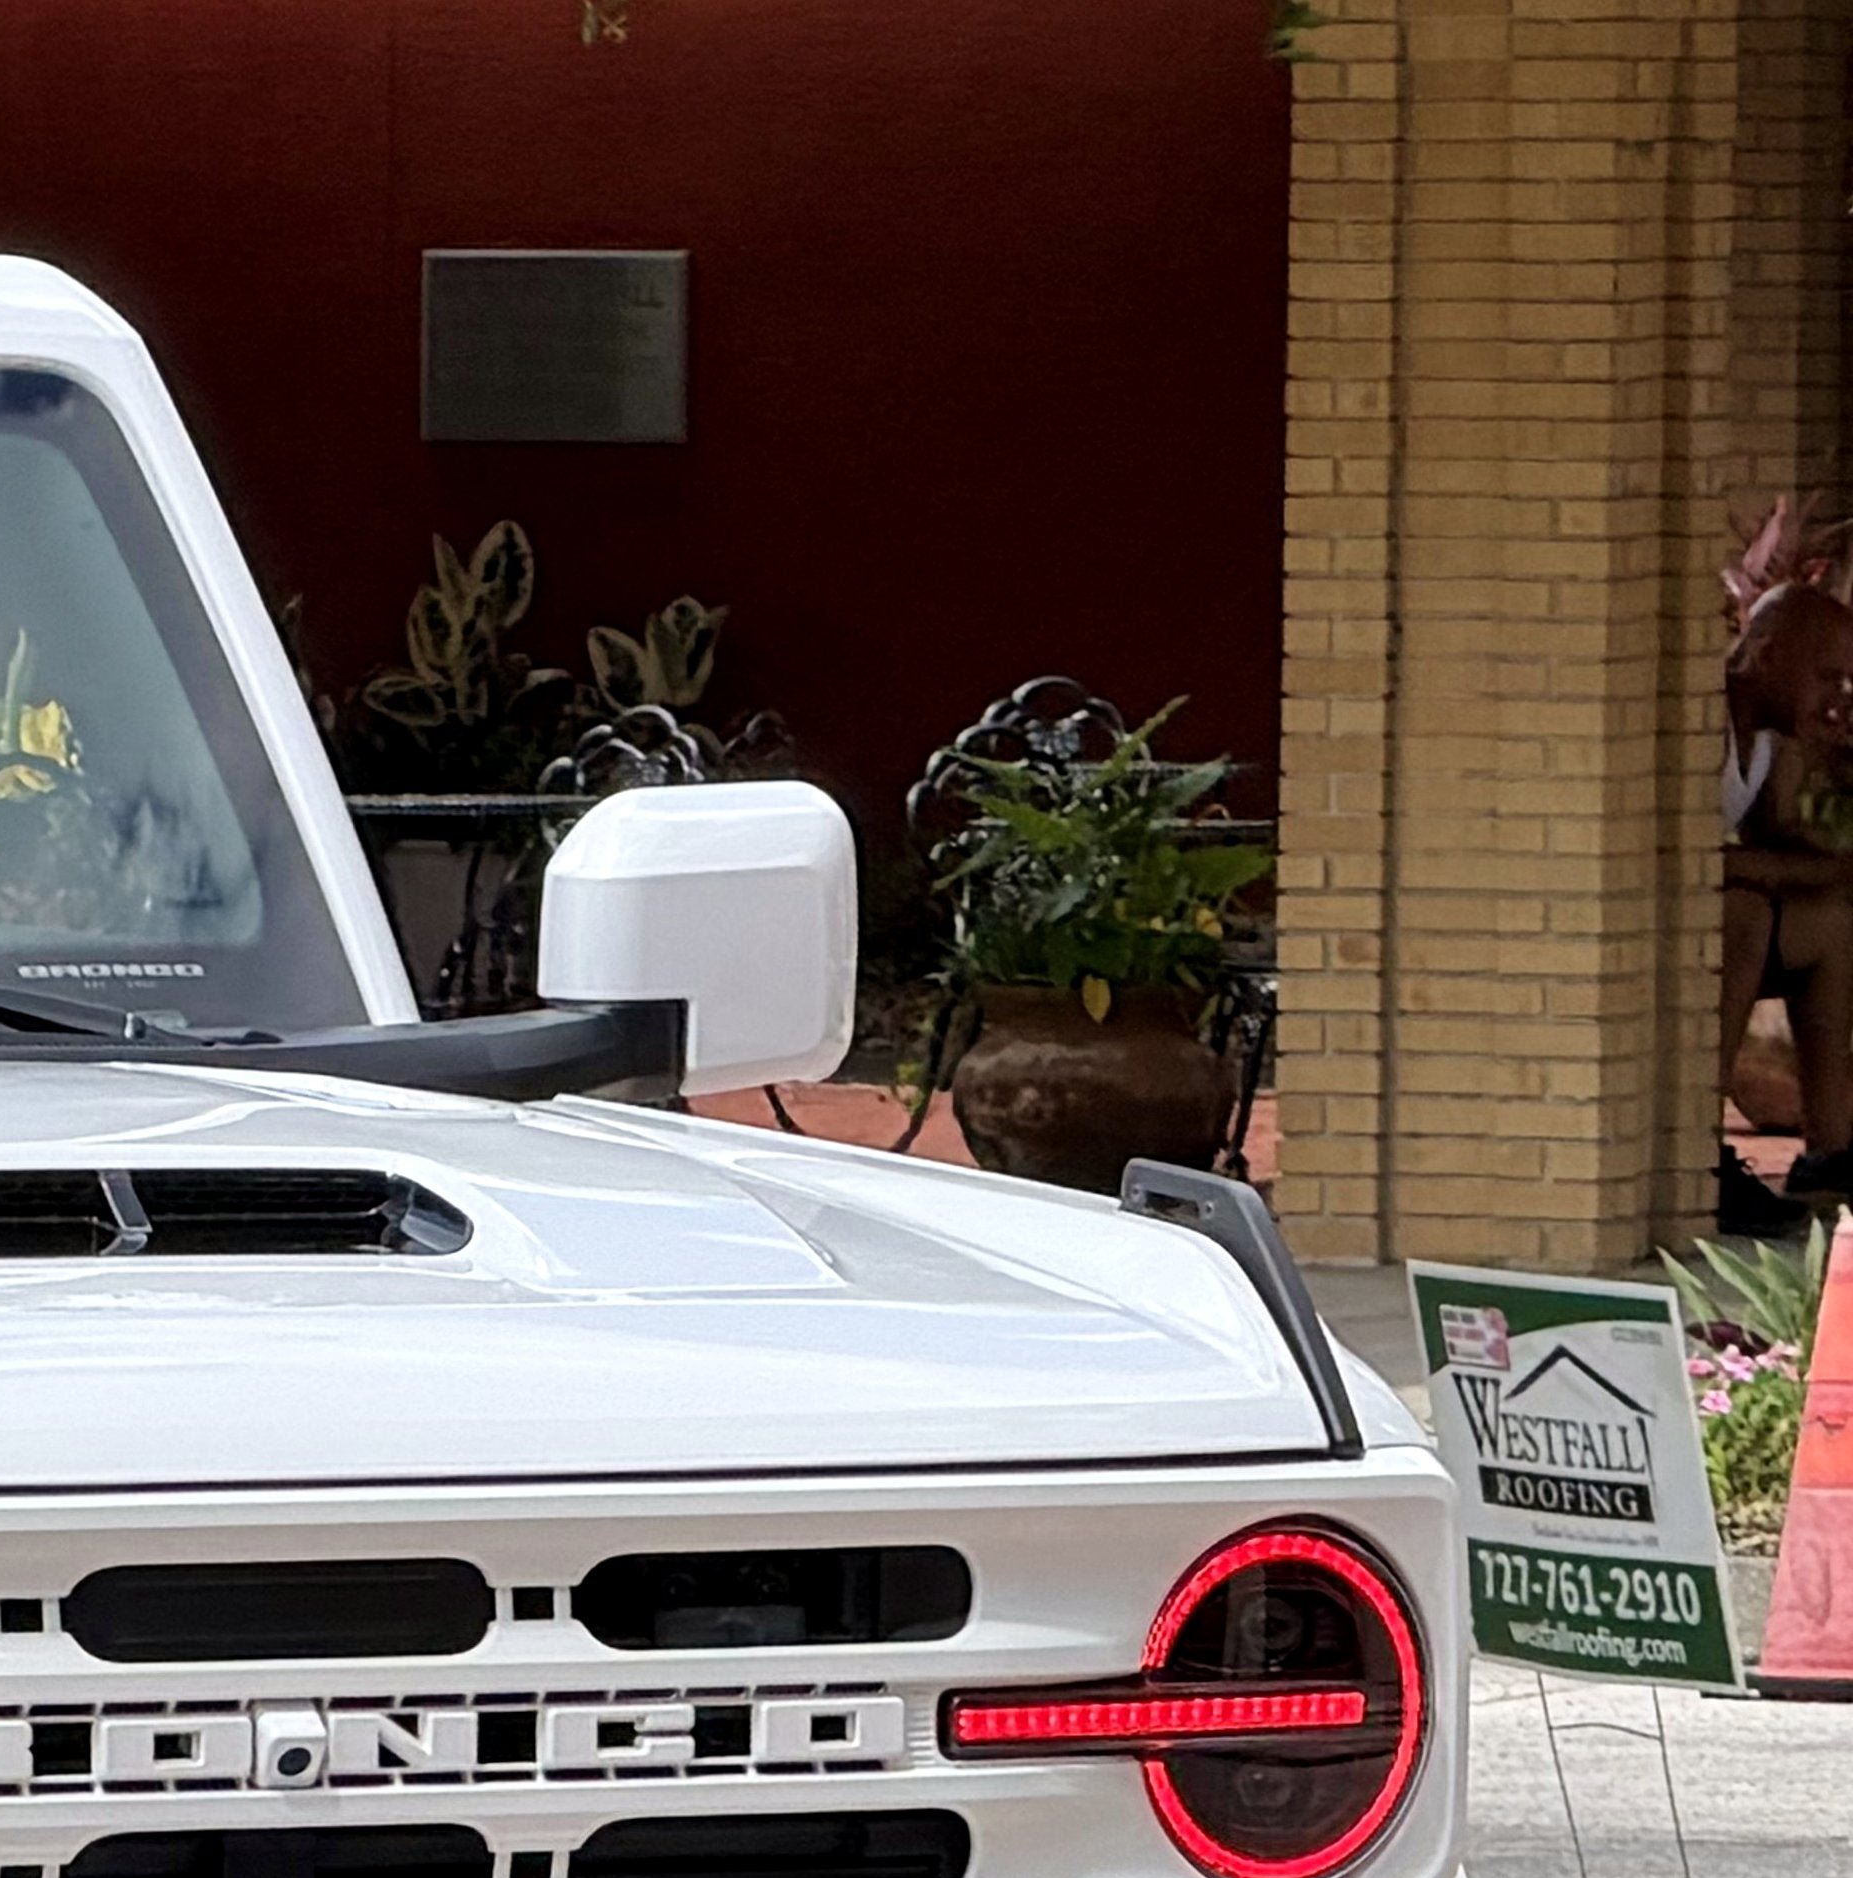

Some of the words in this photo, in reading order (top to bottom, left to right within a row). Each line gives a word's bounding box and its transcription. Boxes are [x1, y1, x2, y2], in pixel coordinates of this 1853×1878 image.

[1452, 1372, 1646, 1474] WESTFALL
[1496, 1472, 1640, 1517] ROOFING
[1508, 1618, 1688, 1668] wroofing.com
